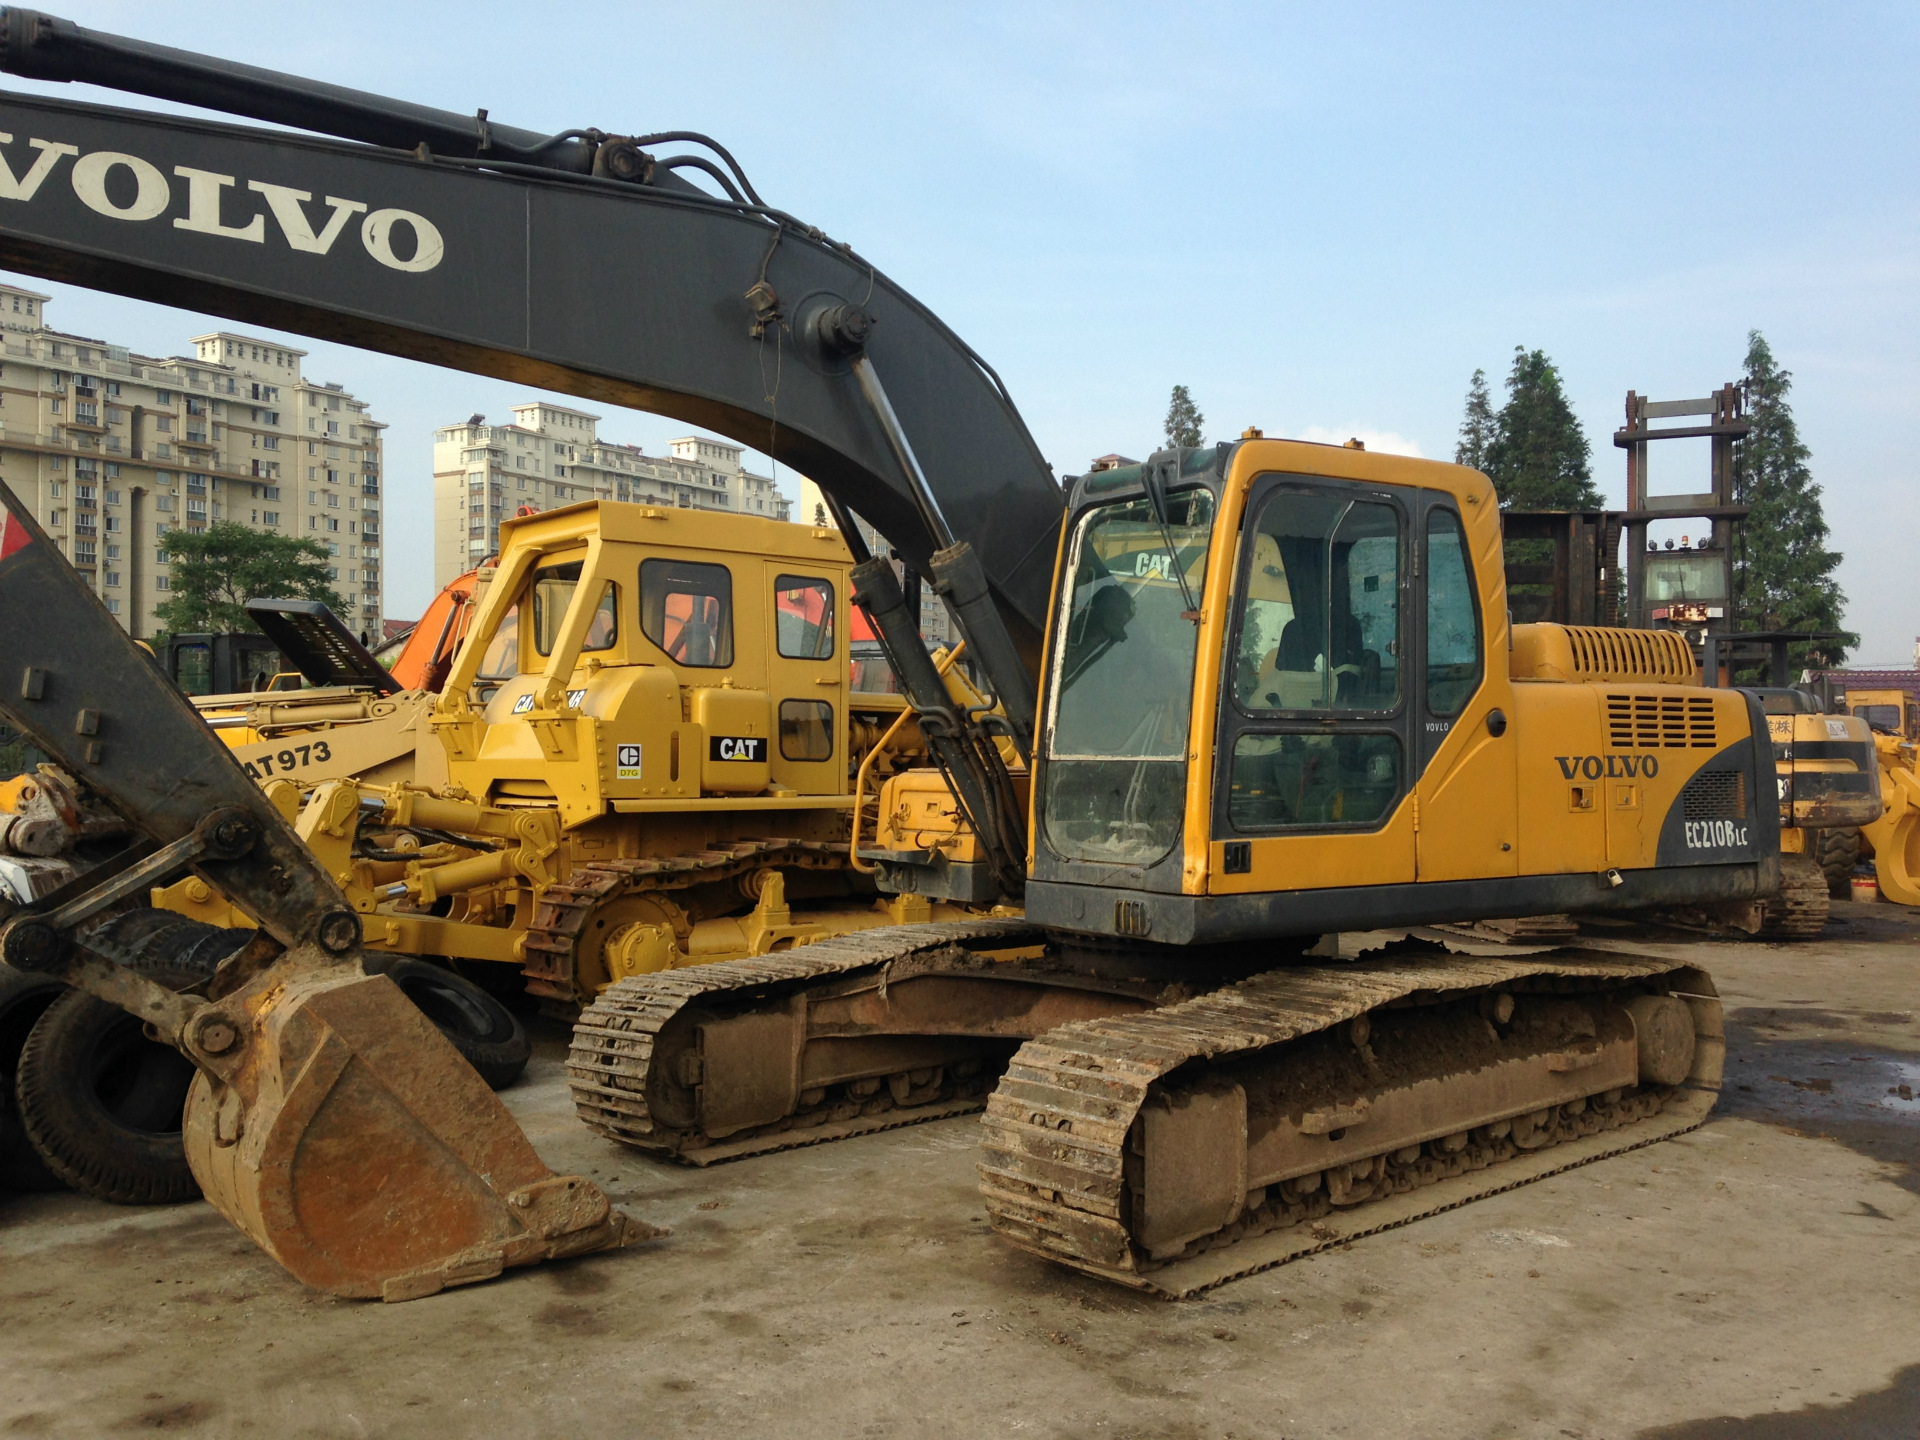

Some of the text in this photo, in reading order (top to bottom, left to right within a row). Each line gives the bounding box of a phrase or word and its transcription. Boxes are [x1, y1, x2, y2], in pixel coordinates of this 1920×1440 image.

[0, 132, 444, 273] VOLVO
[1135, 552, 1171, 581] CAT
[1426, 722, 1449, 732] VOVLO
[244, 741, 331, 780] AT973
[720, 738, 758, 760] CAT
[620, 769, 638, 777] D7G
[1554, 755, 1659, 780] VOLVO
